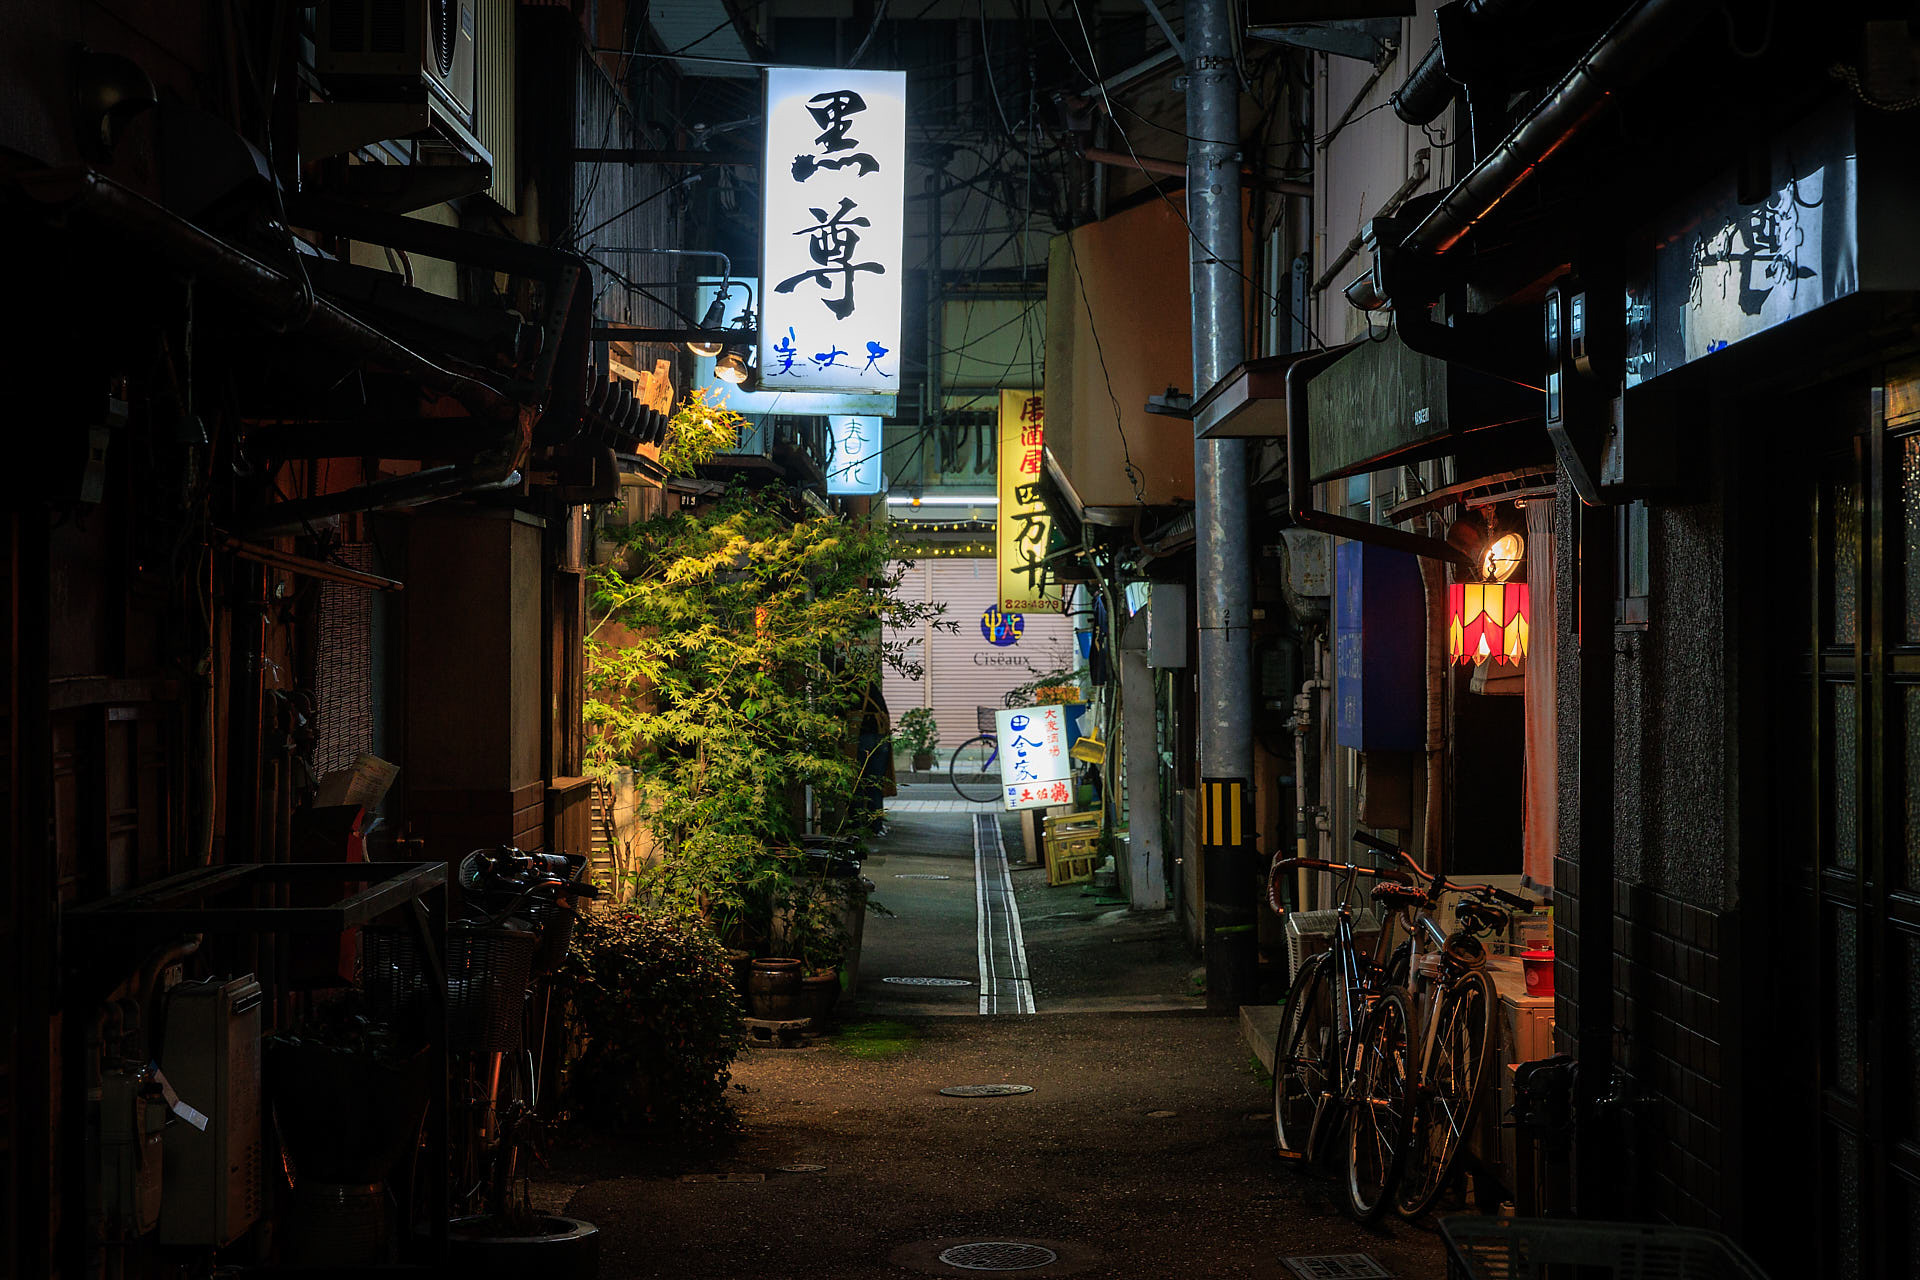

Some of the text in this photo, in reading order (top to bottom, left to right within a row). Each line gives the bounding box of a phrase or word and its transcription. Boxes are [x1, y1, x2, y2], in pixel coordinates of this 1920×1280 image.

[773, 89, 886, 321] 黒尊
[833, 418, 872, 486] 春花
[1019, 396, 1044, 474] 居酒屋
[1020, 781, 1069, 803] 土佐鶴
